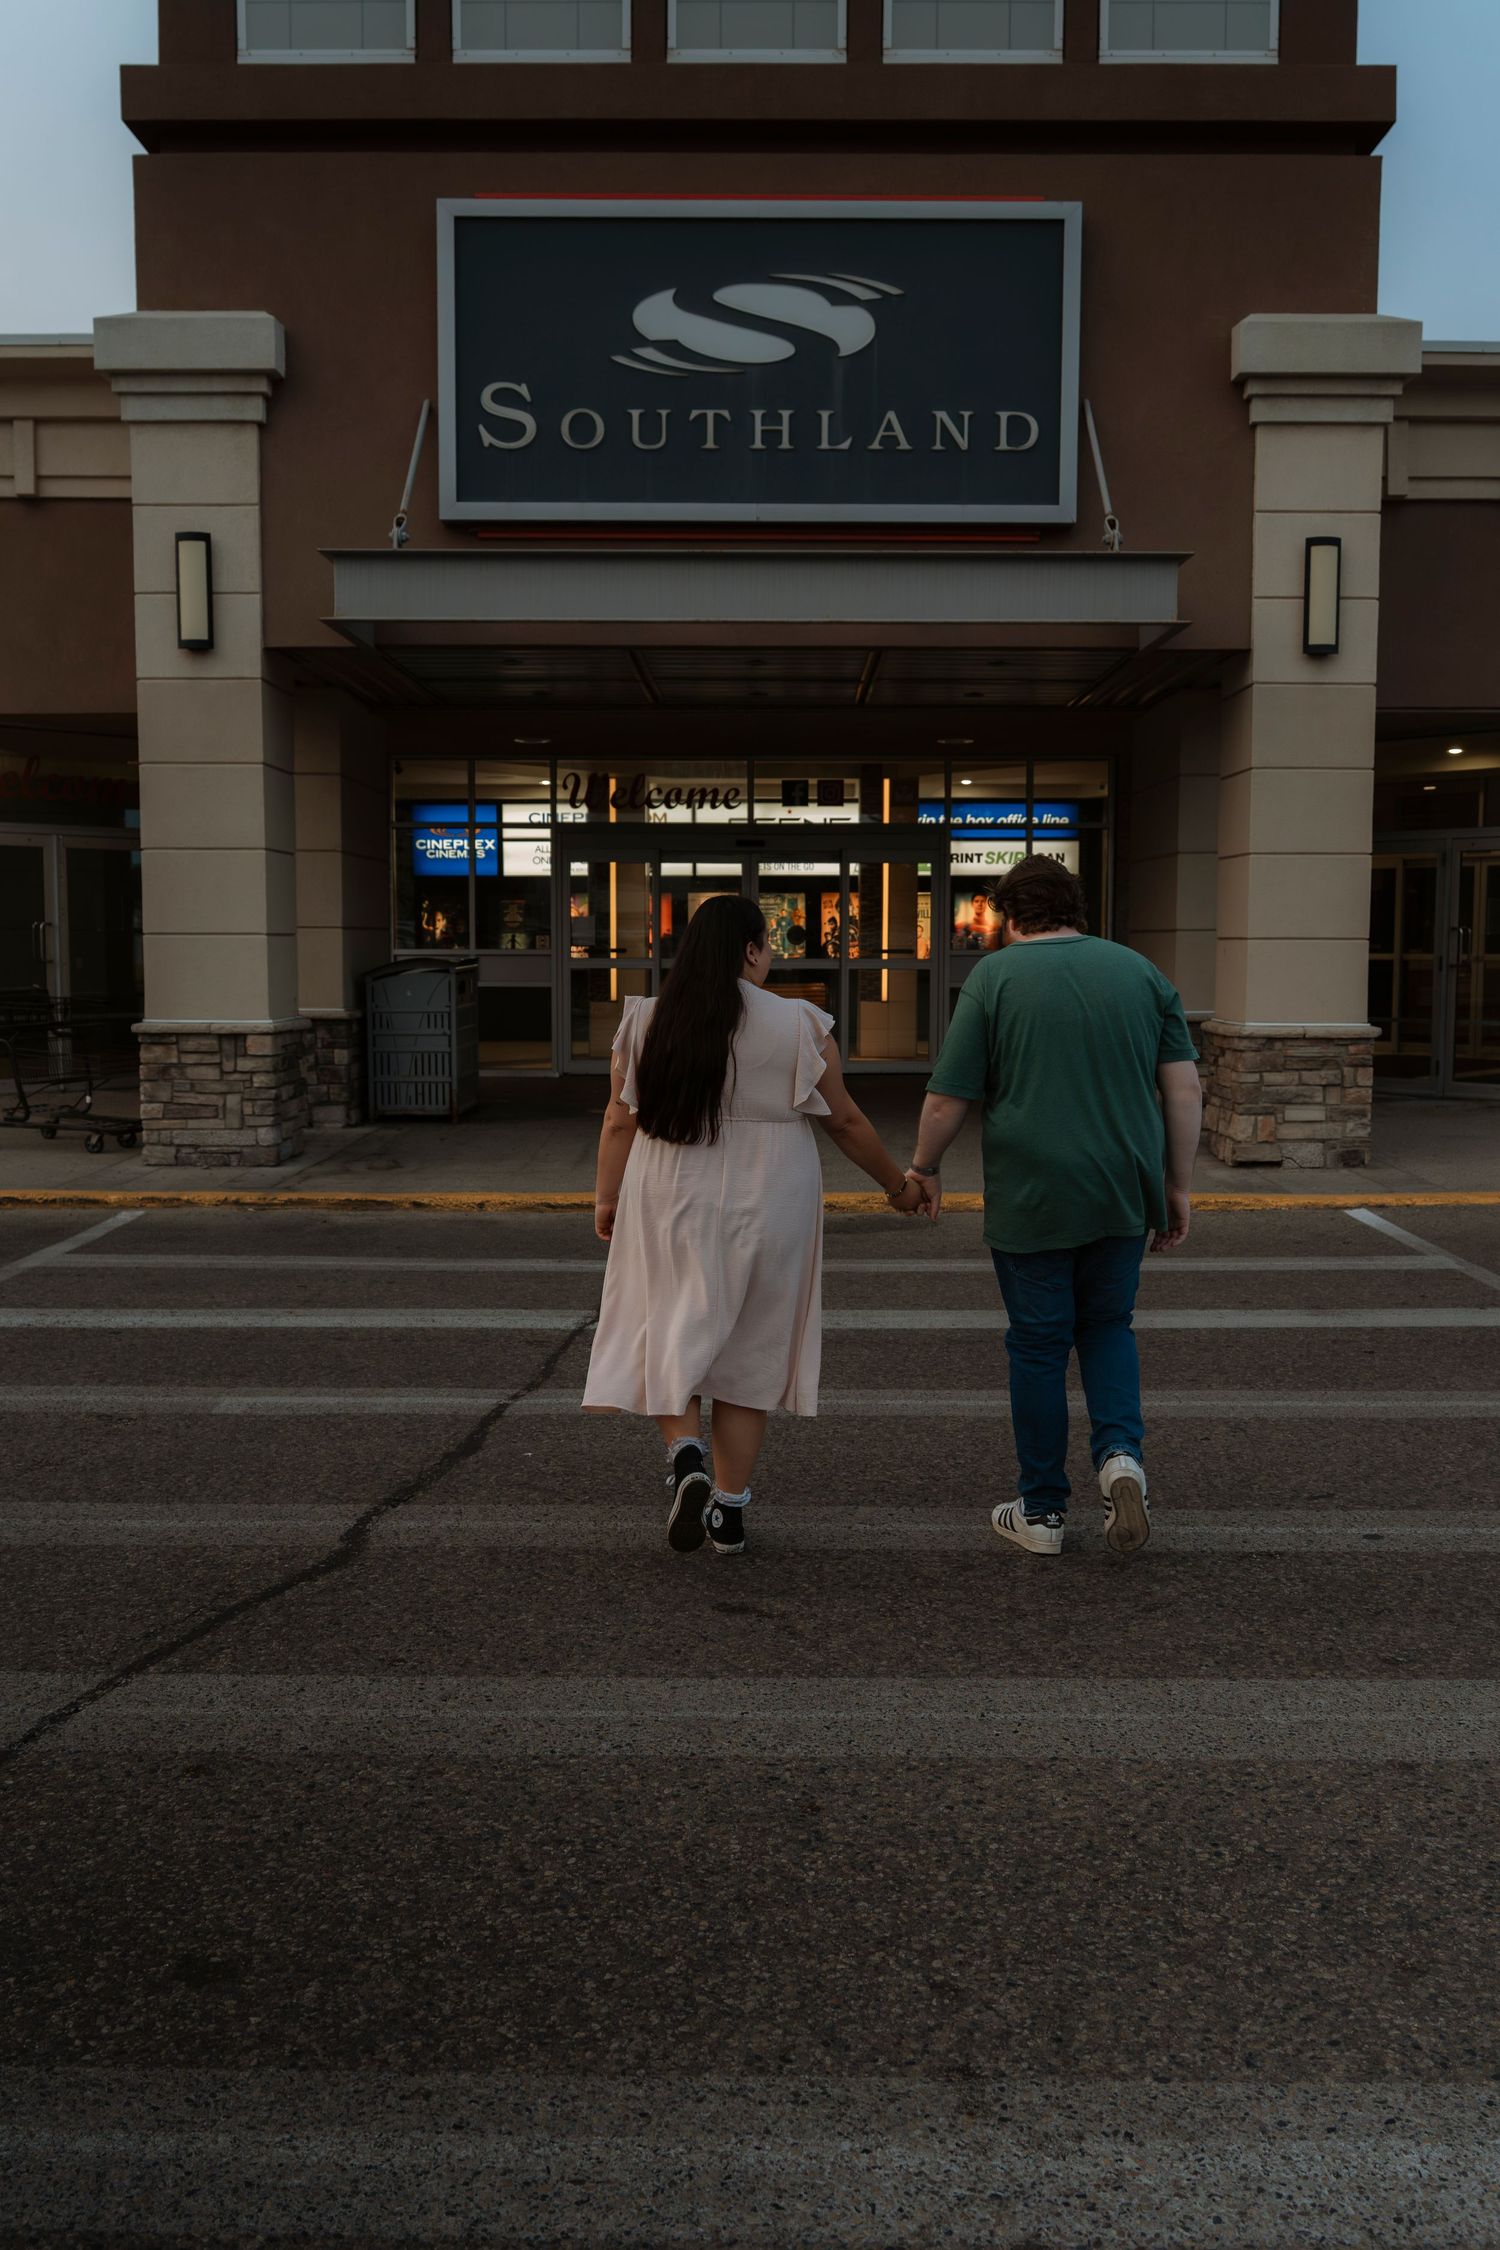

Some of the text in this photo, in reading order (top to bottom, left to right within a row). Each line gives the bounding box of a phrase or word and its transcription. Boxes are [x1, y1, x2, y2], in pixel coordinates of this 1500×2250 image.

[478, 381, 1041, 451] SOUTHLAND
[562, 772, 743, 810] Welcome
[426, 850, 486, 859] CINEMS
[950, 853, 983, 863] RINT
